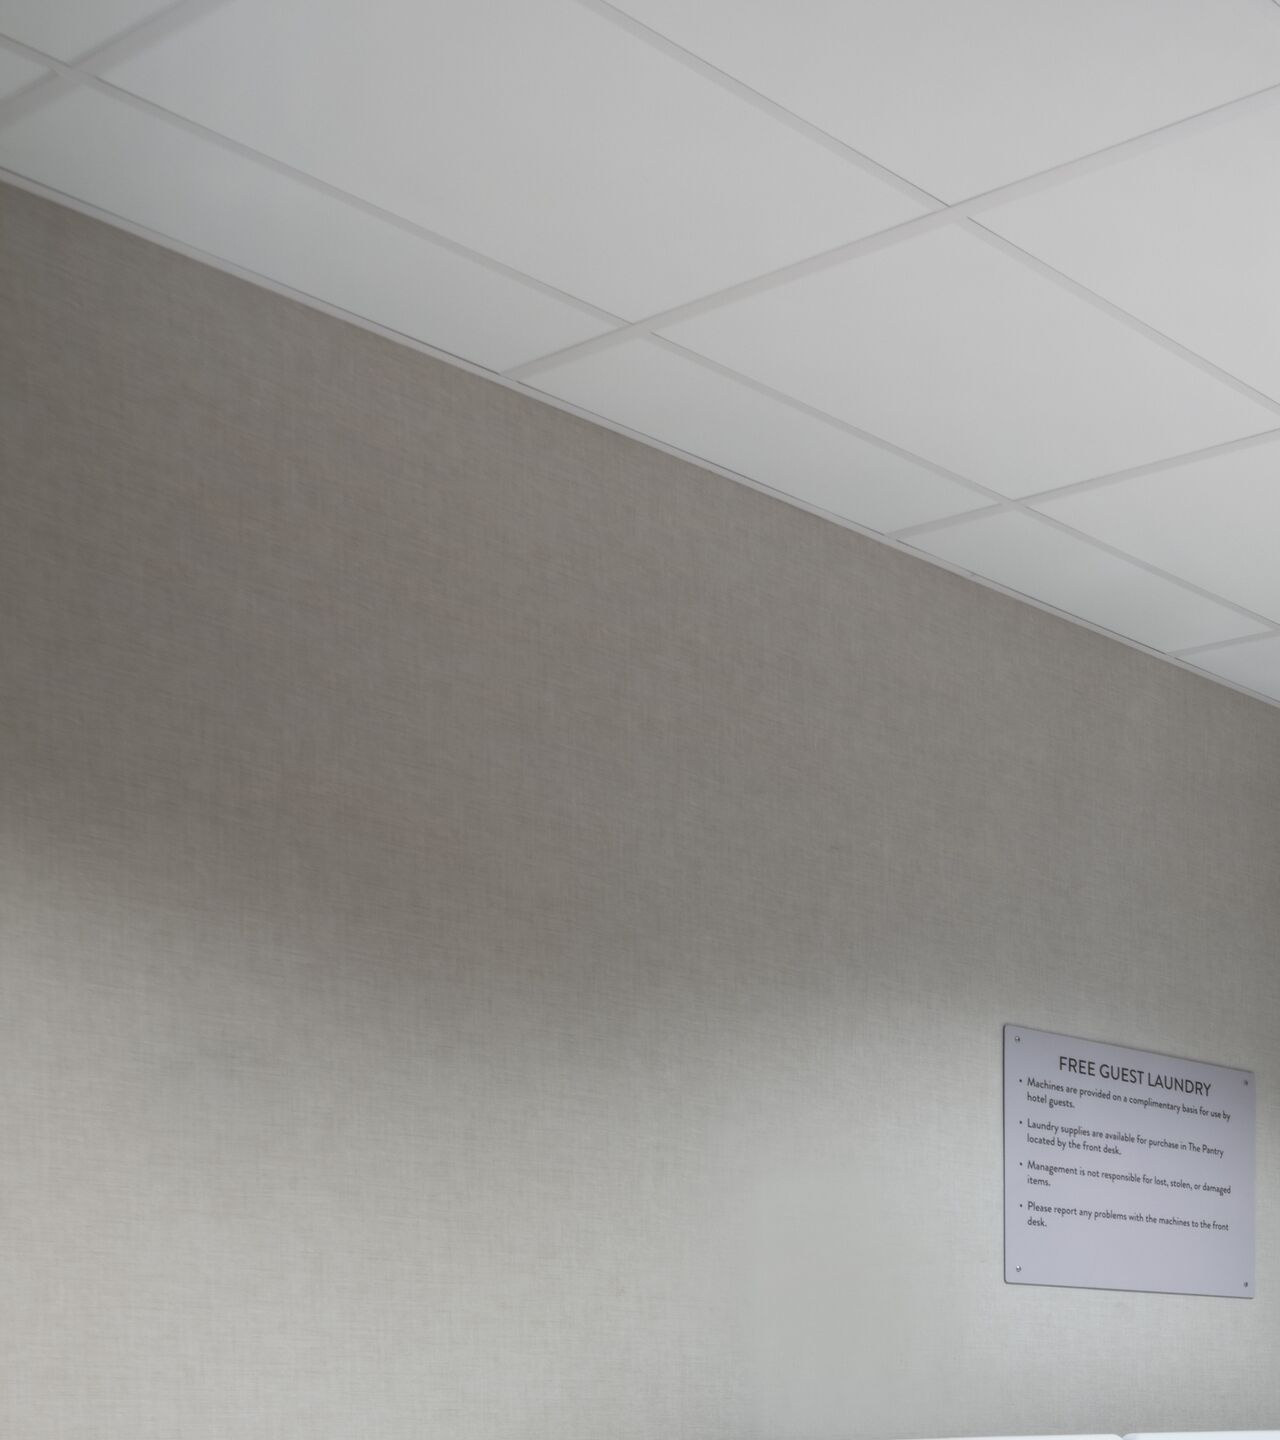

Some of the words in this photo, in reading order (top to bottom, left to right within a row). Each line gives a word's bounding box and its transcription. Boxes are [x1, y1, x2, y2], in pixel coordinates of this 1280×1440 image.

[1059, 1056, 1096, 1076] FREE
[1099, 1064, 1144, 1084] GUEST
[1147, 1072, 1211, 1096] LAUNDRY
[1027, 1077, 1064, 1092] Machines
[1066, 1086, 1078, 1094] are
[1079, 1088, 1111, 1100] provided
[1112, 1094, 1122, 1102] on
[1129, 1097, 1180, 1114] complimentary
[1182, 1103, 1198, 1114] basis
[1199, 1106, 1209, 1116] for
[1210, 1111, 1221, 1119] use
[1222, 1110, 1231, 1122] by
[1027, 1091, 1047, 1103] hotel
[1048, 1098, 1075, 1109] guests.
[1027, 1118, 1059, 1134] Laundry
[1061, 1125, 1090, 1137] supplies
[1092, 1130, 1104, 1138] are
[1105, 1131, 1135, 1143] available
[1136, 1134, 1147, 1144] for
[1148, 1139, 1179, 1149] purchase
[1180, 1141, 1187, 1150] in
[1188, 1142, 1201, 1152] The
[1202, 1144, 1224, 1158] Pantry
[1027, 1133, 1056, 1146] located
[1057, 1138, 1067, 1150] by
[1068, 1139, 1081, 1149] the
[1082, 1141, 1101, 1152] front
[1103, 1144, 1122, 1155] desk.
[1027, 1160, 1078, 1176] Management
[1079, 1166, 1085, 1176] is
[1087, 1170, 1100, 1178] not
[1101, 1171, 1141, 1183] responsible
[1142, 1174, 1153, 1184] for
[1154, 1176, 1169, 1188] lost,
[1170, 1179, 1193, 1191] stolen,
[1202, 1182, 1231, 1196] damaged
[1027, 1174, 1051, 1186] items.
[1027, 1200, 1053, 1213] Please
[1053, 1206, 1077, 1217] report
[1079, 1209, 1092, 1220] any
[1094, 1209, 1127, 1220] problems
[1128, 1212, 1144, 1222] with
[1145, 1214, 1157, 1223] the
[1158, 1216, 1190, 1227] machines
[1191, 1219, 1199, 1228] to
[1200, 1219, 1211, 1229] the
[1212, 1220, 1229, 1231] front
[1027, 1216, 1048, 1227] desk.
